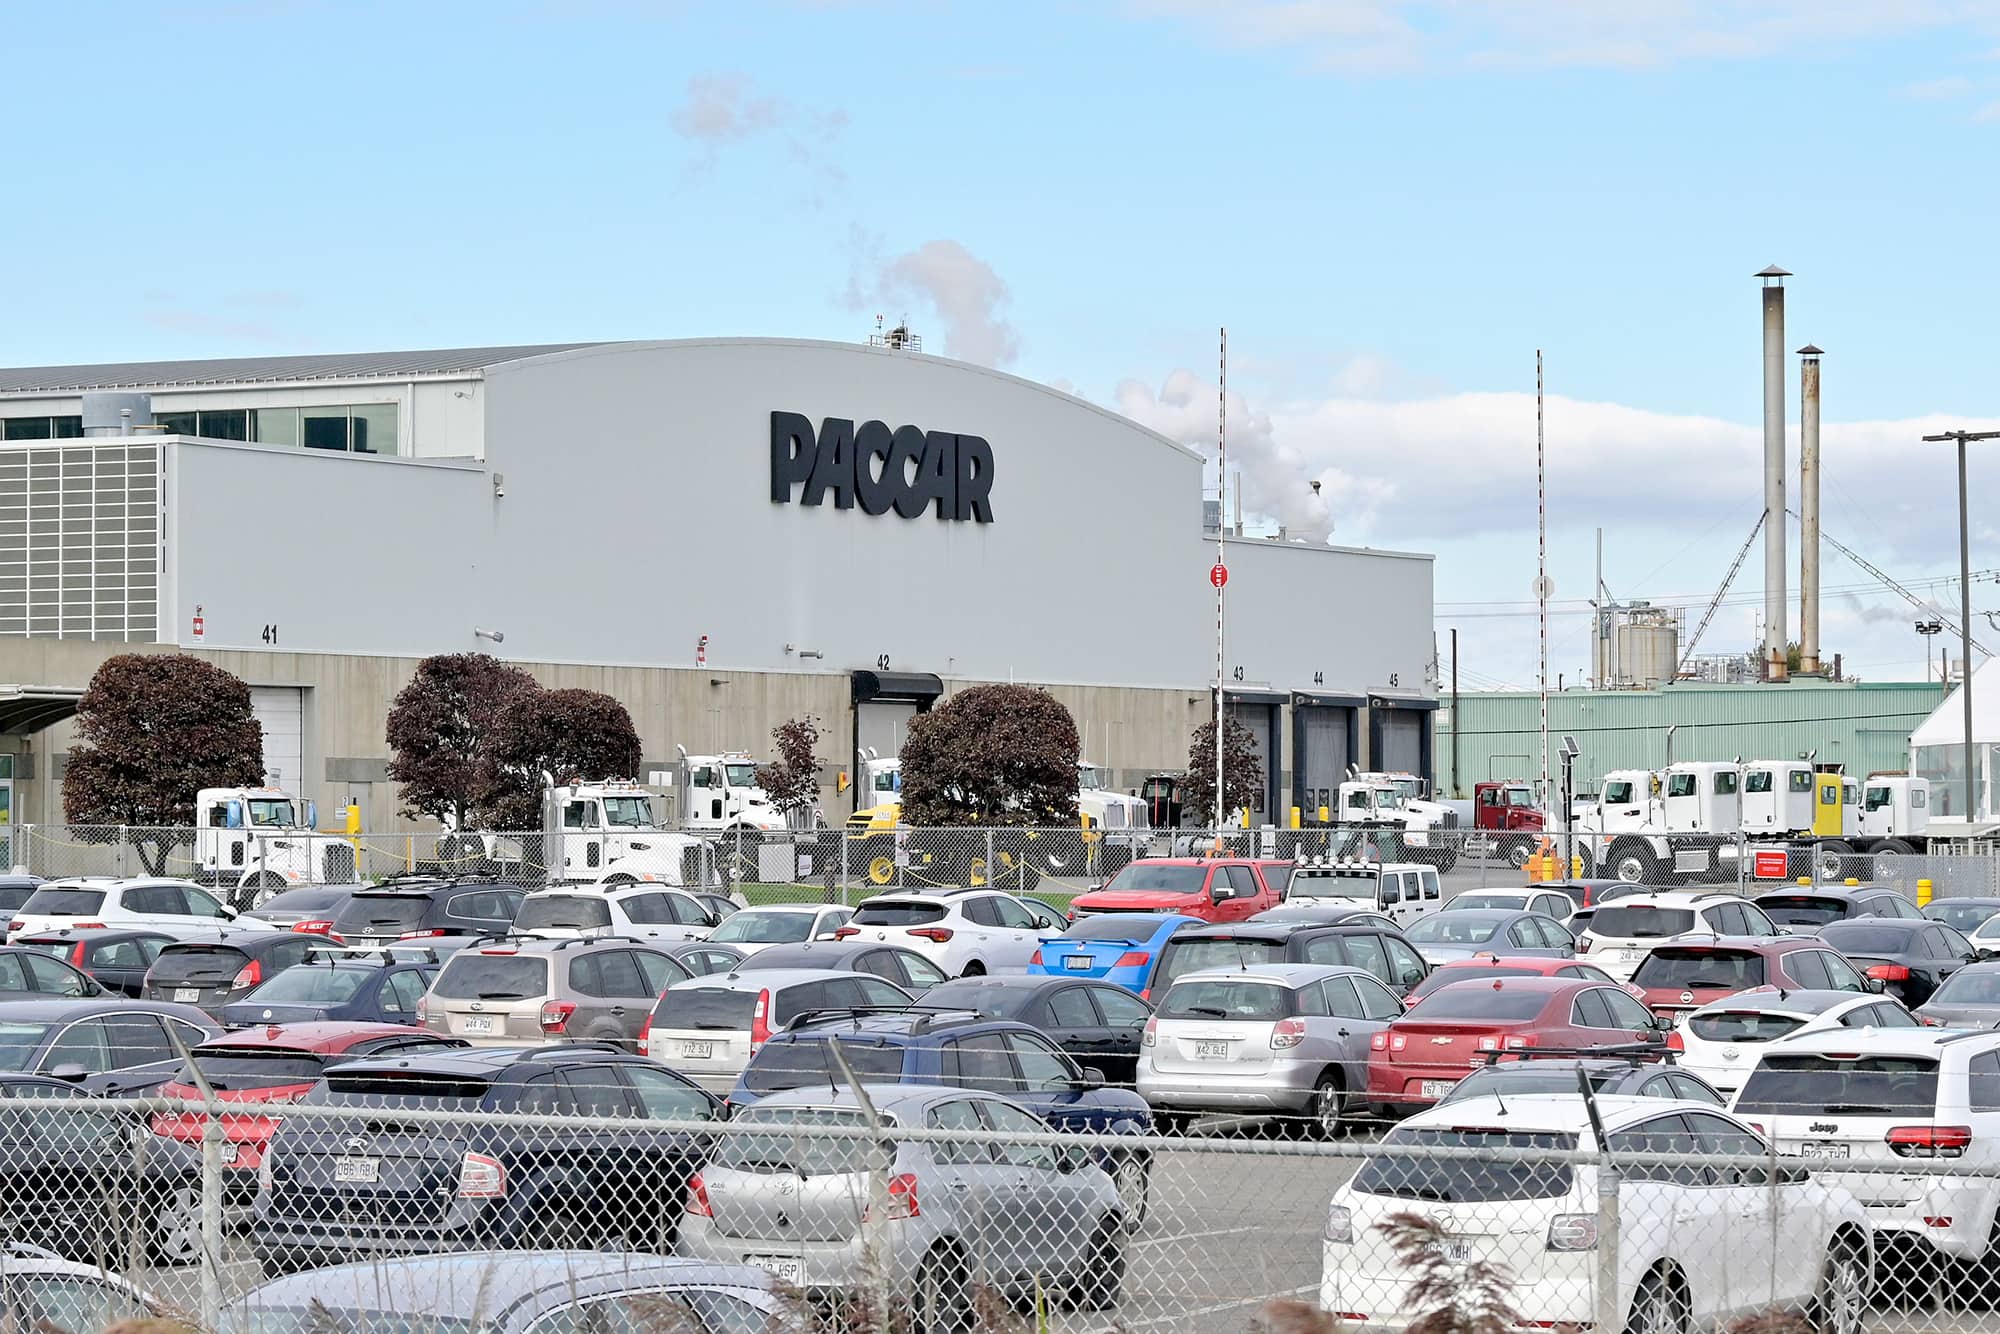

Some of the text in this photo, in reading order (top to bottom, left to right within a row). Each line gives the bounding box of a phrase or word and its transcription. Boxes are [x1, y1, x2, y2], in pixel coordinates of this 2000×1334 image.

[771, 410, 994, 523] PACCAR
[262, 624, 277, 645] 41
[877, 654, 890, 671] 42
[1233, 666, 1244, 681] 43
[1313, 671, 1323, 686] 44
[1389, 673, 1399, 687] 45
[1197, 1045, 1209, 1055] X42
[1809, 1122, 1838, 1134] Jeep
